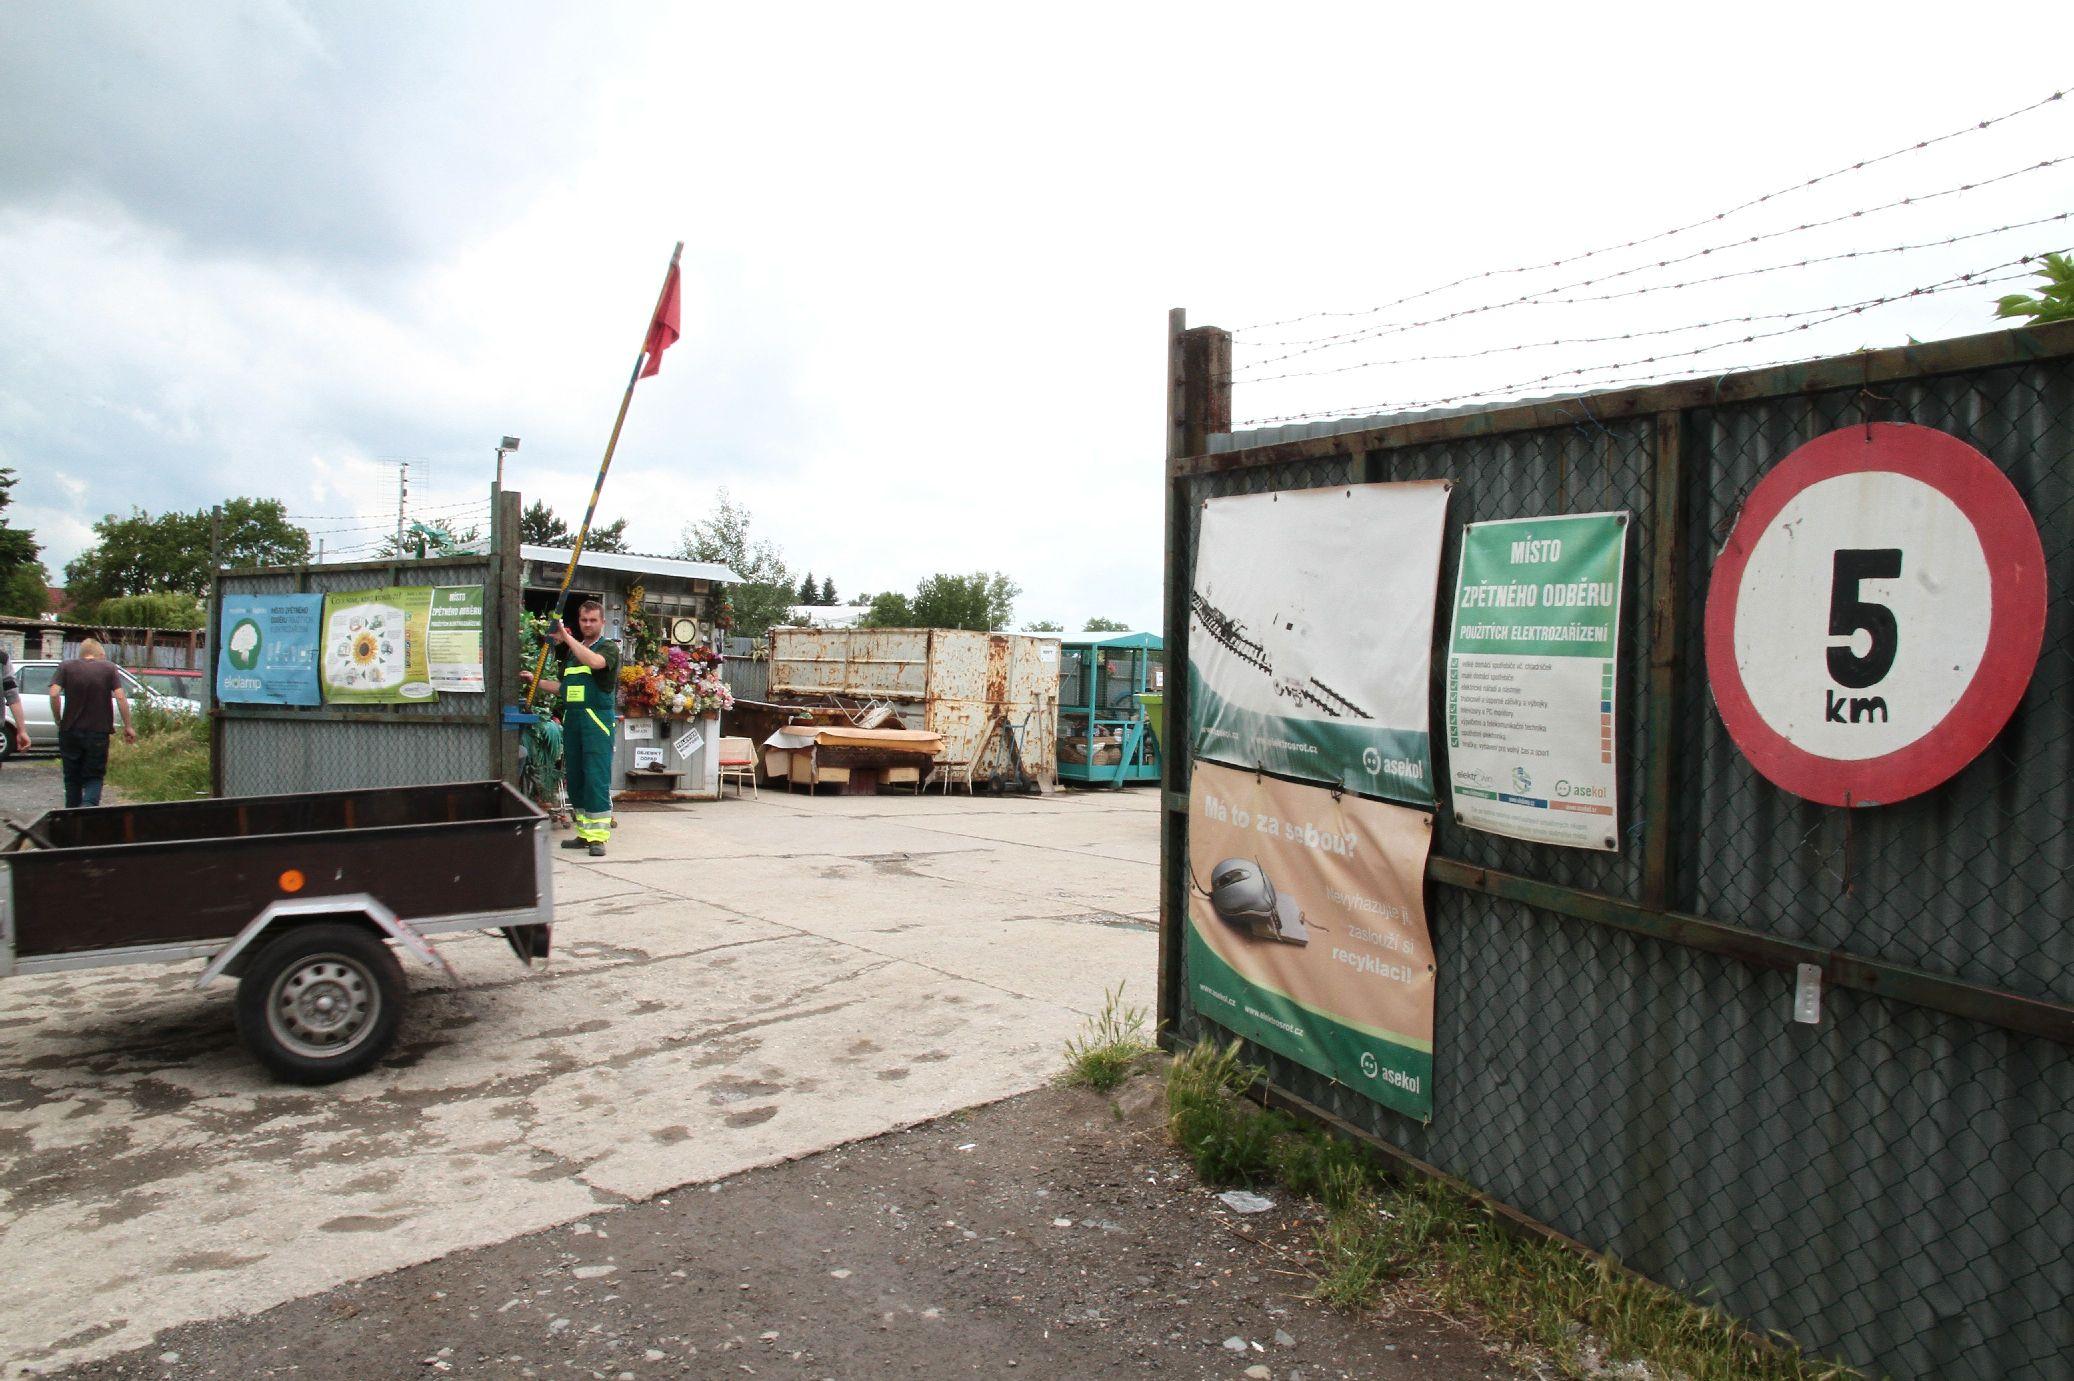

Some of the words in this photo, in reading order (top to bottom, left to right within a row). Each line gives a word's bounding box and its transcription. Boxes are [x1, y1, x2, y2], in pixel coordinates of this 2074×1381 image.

[1510, 535, 1561, 564] MÍSTO
[1461, 579, 1538, 608] ZPĚTNÉHO
[1542, 577, 1613, 607] ODBĚRU
[1460, 622, 1508, 640] POUŽITÝCH
[1511, 622, 1608, 642] ELEKTROZAŘÍZENÍ
[1826, 548, 1903, 689] 5
[224, 675, 262, 690] ekolamp
[1825, 689, 1888, 724] km
[1383, 758, 1423, 779] asekol
[1574, 785, 1606, 798] asekol
[1204, 795, 1227, 822] Má
[1231, 804, 1250, 828] to
[1256, 814, 1280, 836] za
[1285, 822, 1359, 858] sebou?
[1348, 924, 1400, 951] zaslouží
[1402, 938, 1414, 955] si
[1332, 947, 1412, 985] recyklaci!
[1382, 1067, 1420, 1094] asekol
